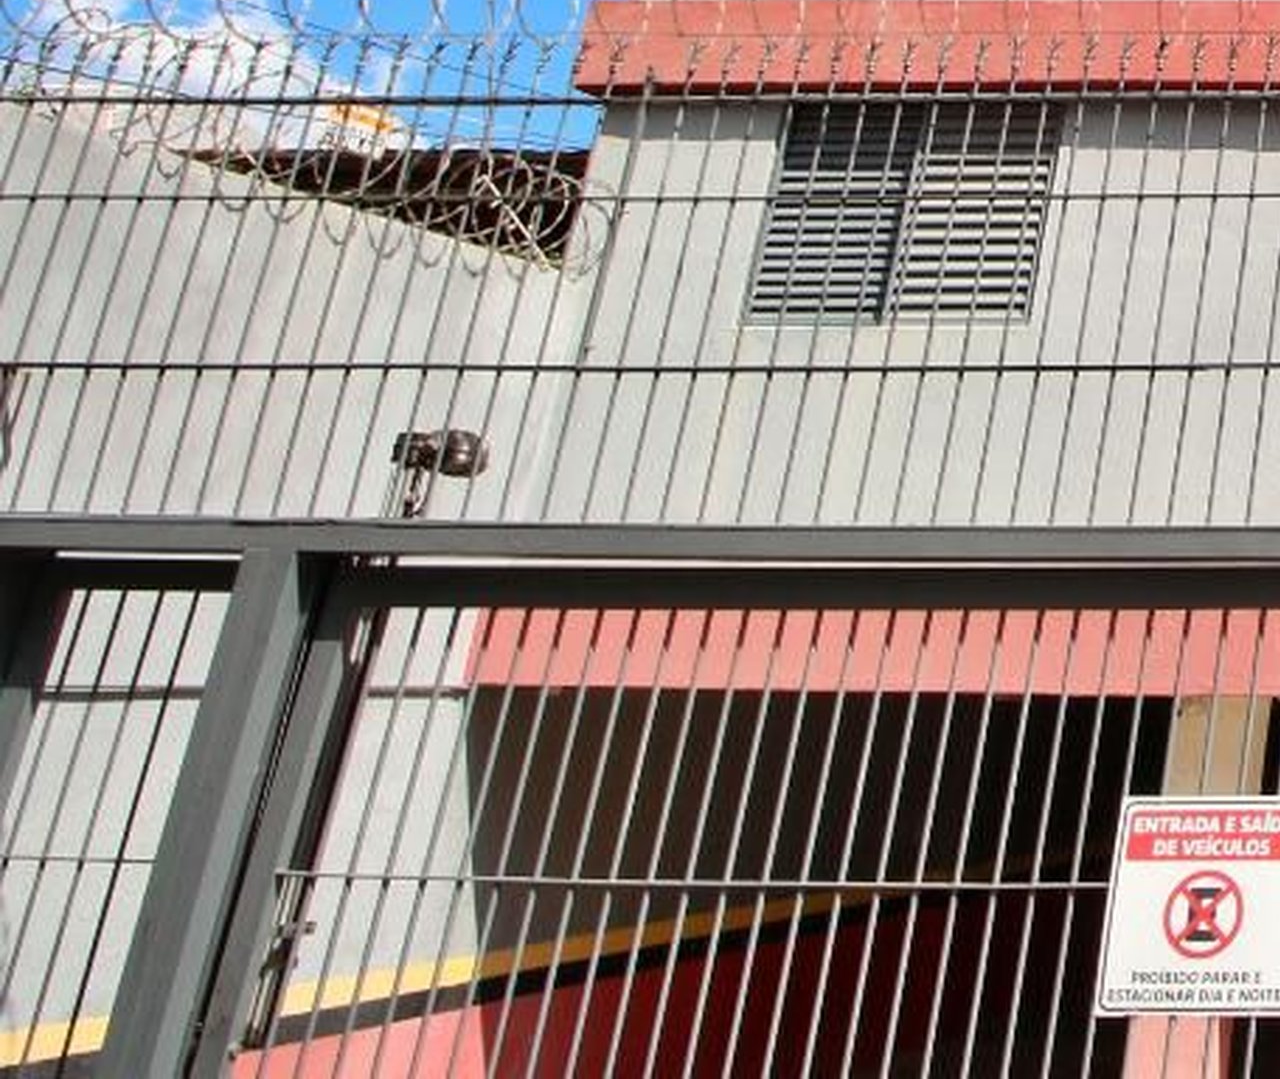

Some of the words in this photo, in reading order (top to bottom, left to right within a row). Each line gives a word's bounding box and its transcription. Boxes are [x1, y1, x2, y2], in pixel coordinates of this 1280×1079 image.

[1133, 815, 1221, 834] ENTRADA
[1224, 816, 1238, 834] E
[1152, 837, 1179, 856] DE
[1181, 833, 1272, 856] VEÍCULOS
[1130, 971, 1200, 985] PROIBIDO
[1201, 971, 1251, 985] PARAR
[1106, 988, 1196, 1003] ESTACIONAR
[1198, 989, 1224, 1003] DIA
[1226, 989, 1236, 1003] E
